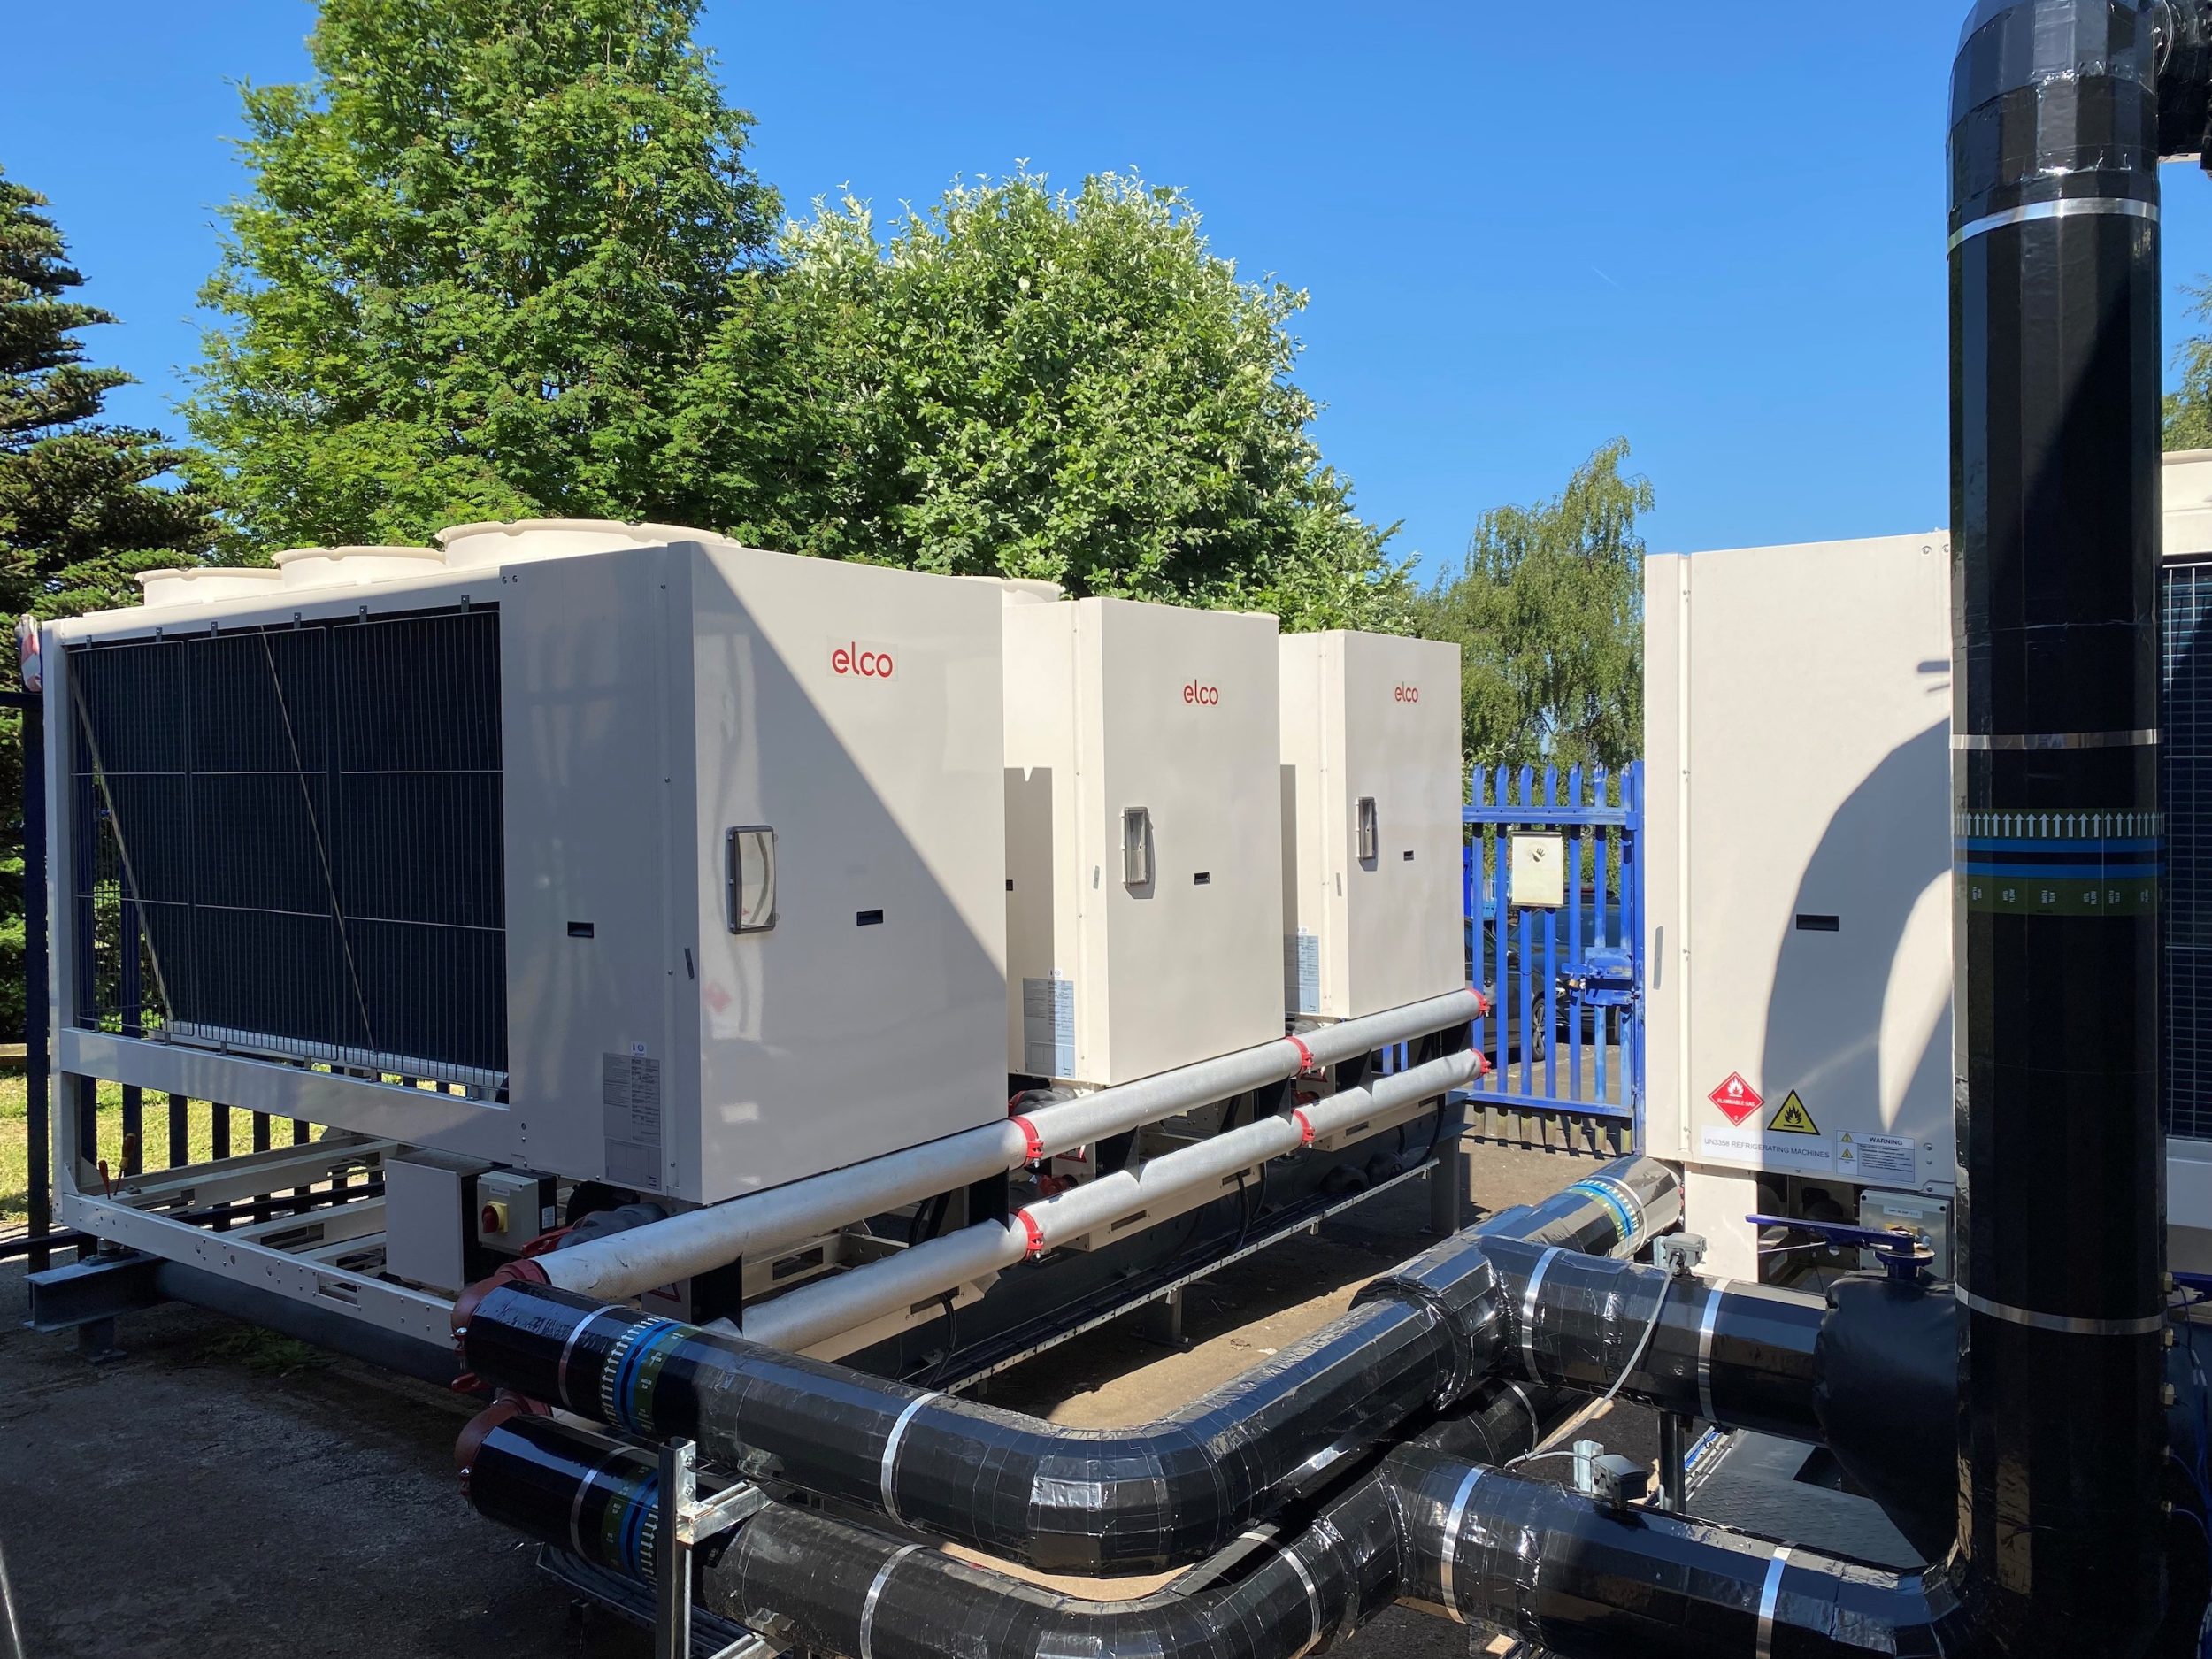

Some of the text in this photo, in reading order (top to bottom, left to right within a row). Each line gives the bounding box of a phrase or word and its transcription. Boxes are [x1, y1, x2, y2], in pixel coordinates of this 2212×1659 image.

[832, 641, 894, 680] elco
[1184, 679, 1218, 706] elco
[1394, 681, 1418, 703] elco
[1704, 1138, 1830, 1158] UN3358 REFRIGERATING MACHINES
[1869, 1136, 1903, 1146] WARNING
